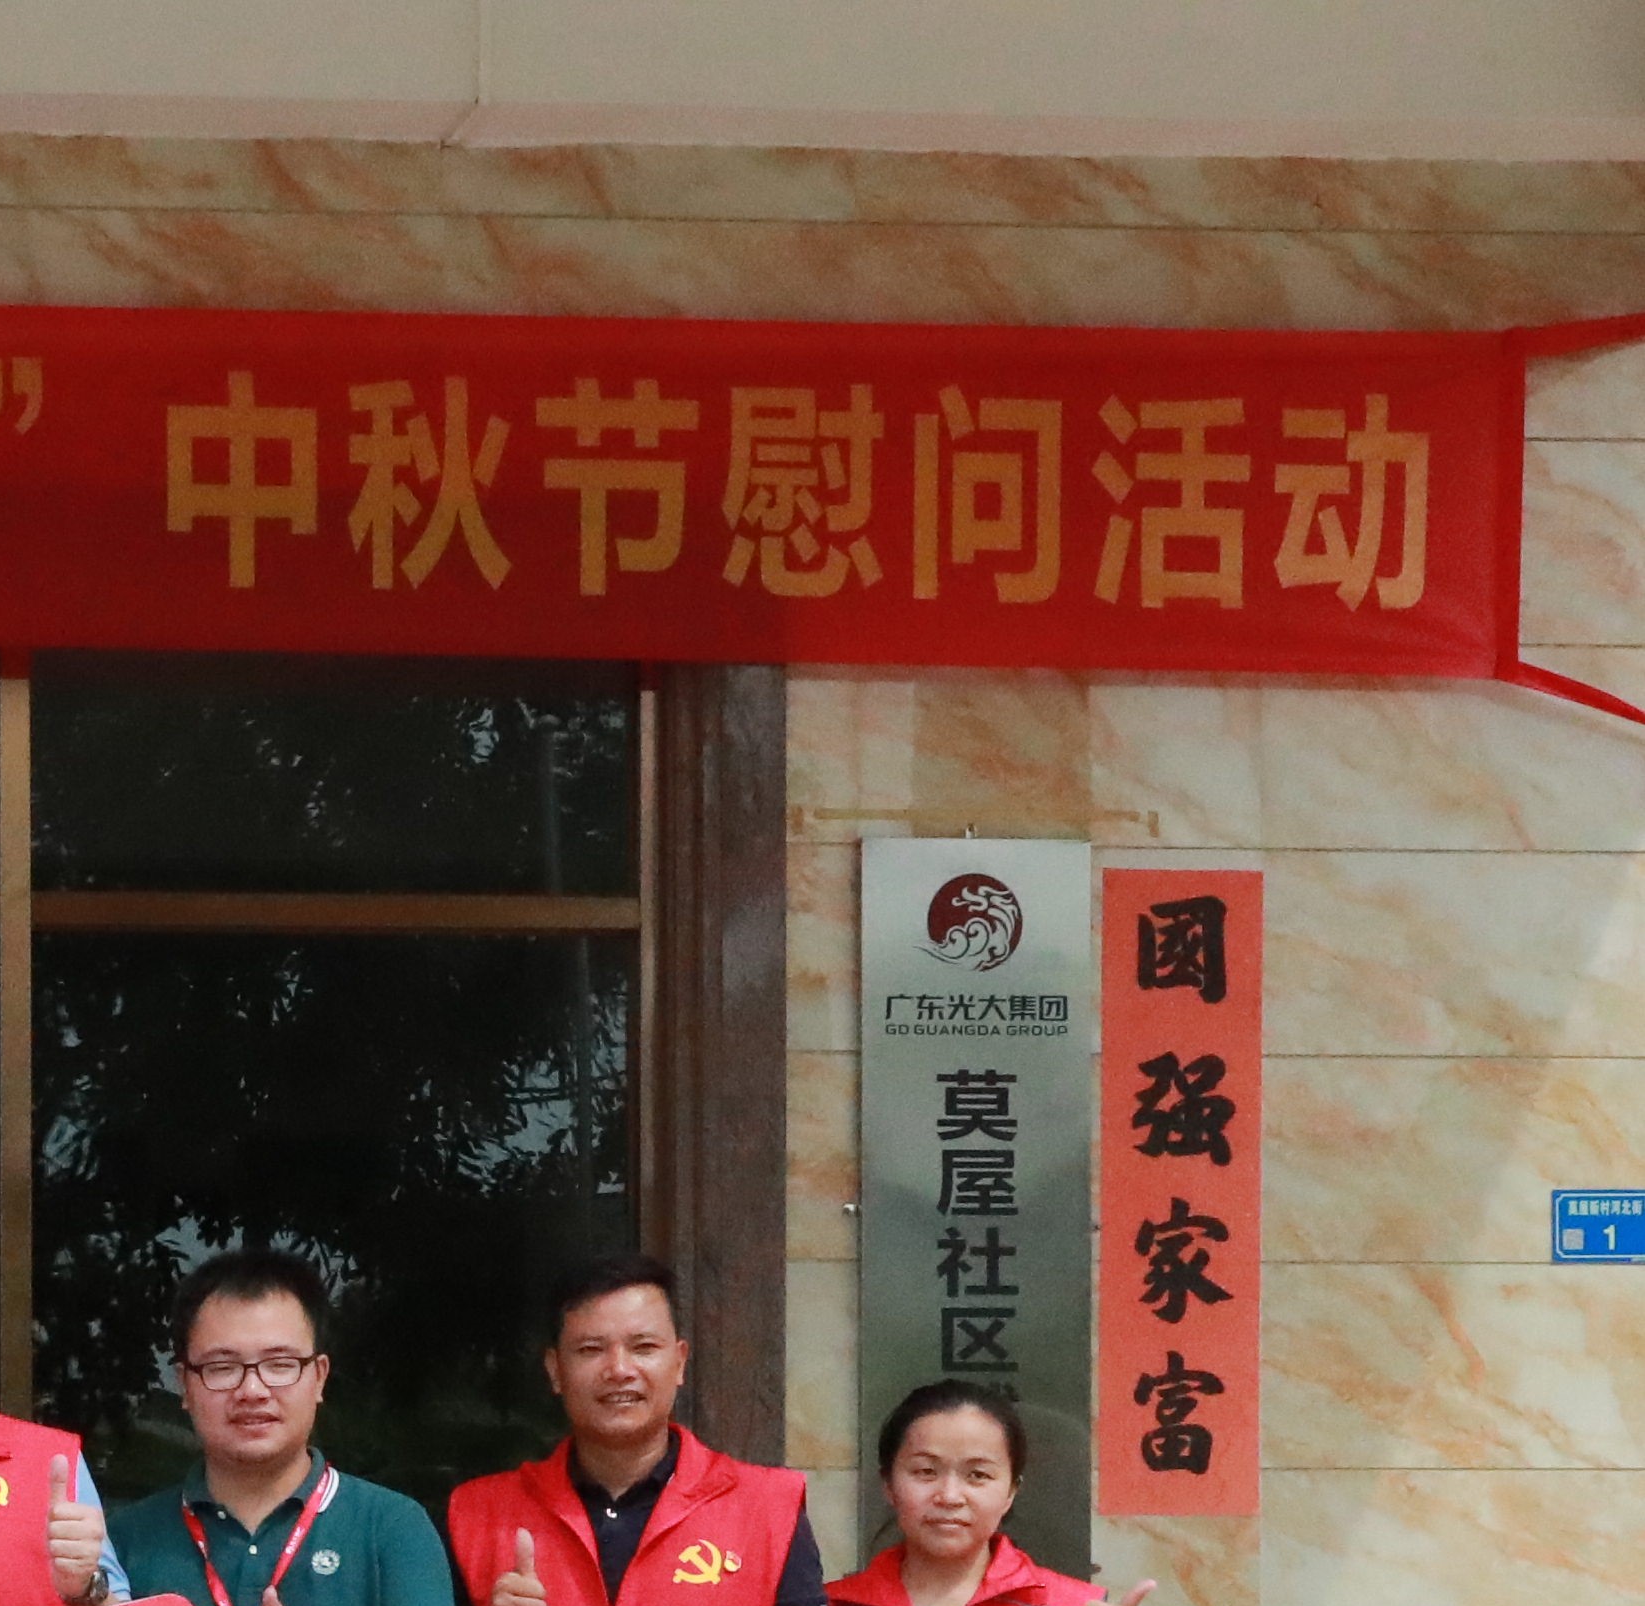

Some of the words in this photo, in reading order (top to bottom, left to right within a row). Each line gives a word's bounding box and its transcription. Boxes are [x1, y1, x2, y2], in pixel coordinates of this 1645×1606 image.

[885, 993, 1069, 1021] 广东光大集团
[885, 1024, 909, 1035] GD
[914, 1024, 1001, 1036] GUANGDA
[1006, 1025, 1068, 1036] GROUP
[935, 1069, 1019, 1404] 莫屋社区
[1603, 1224, 1616, 1251] 1
